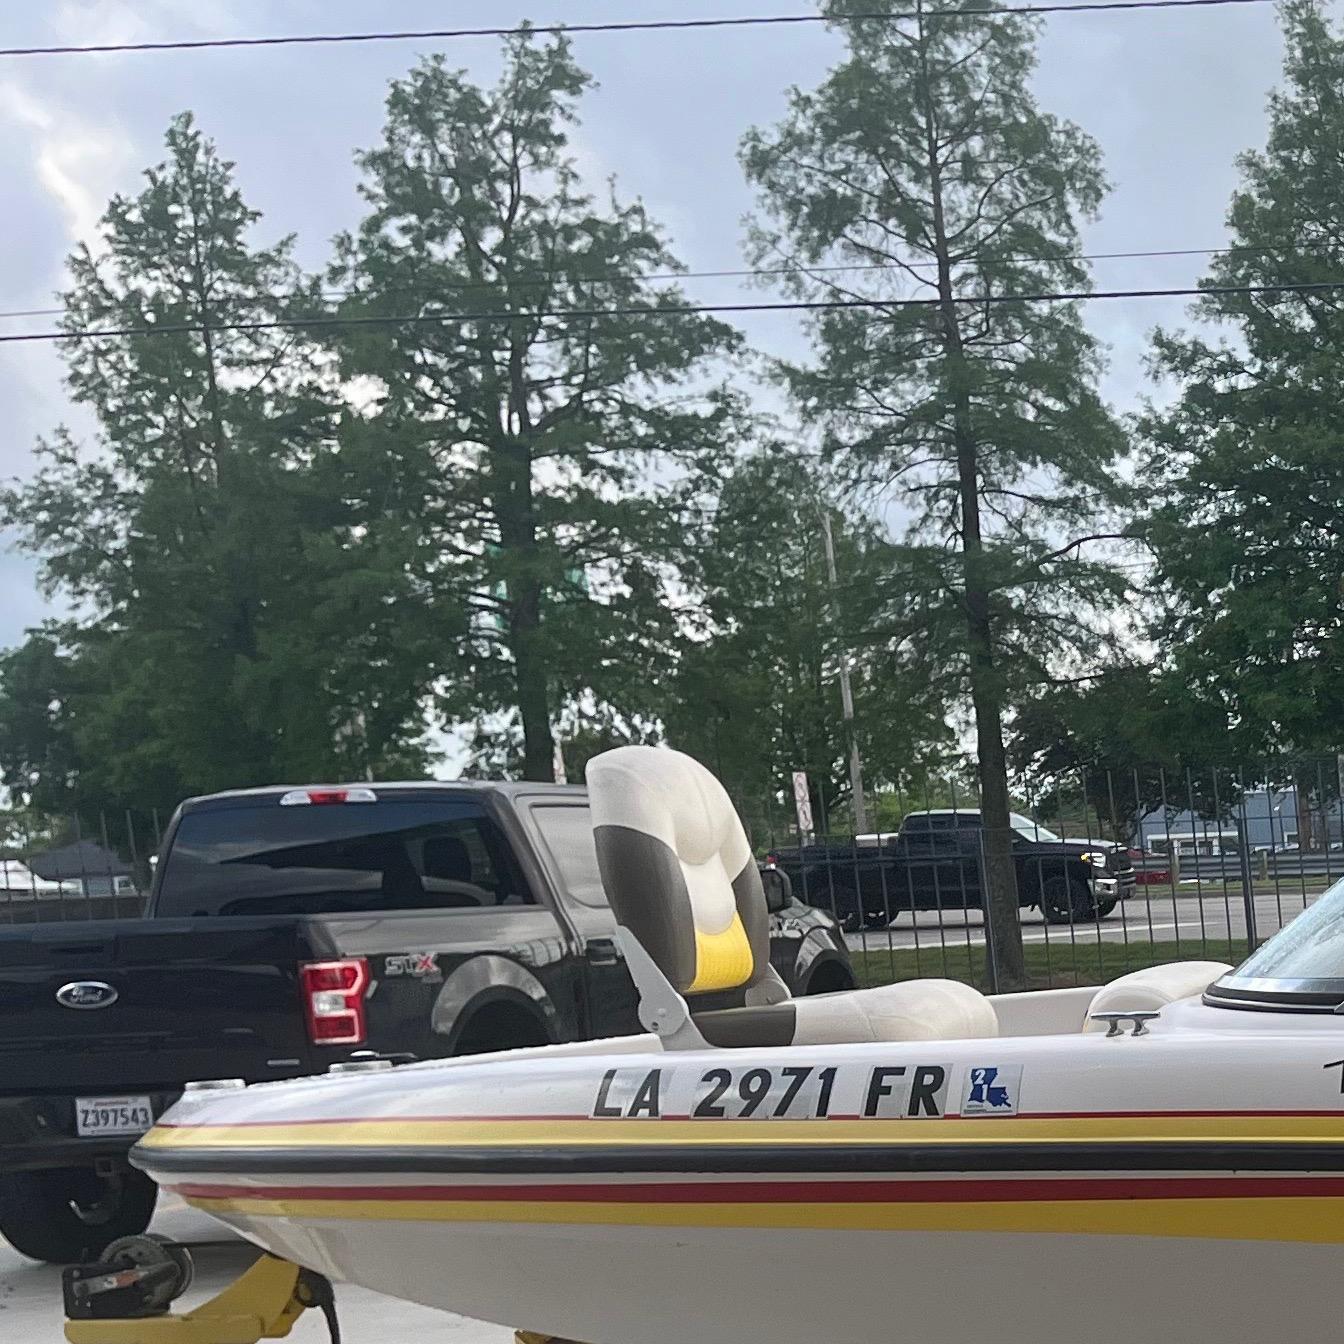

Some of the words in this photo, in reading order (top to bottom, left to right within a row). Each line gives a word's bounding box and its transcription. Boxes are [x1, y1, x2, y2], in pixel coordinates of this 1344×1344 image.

[385, 952, 441, 976] STX
[593, 1068, 662, 1118] LA
[692, 1066, 839, 1118] 2971
[864, 1065, 946, 1118] FR
